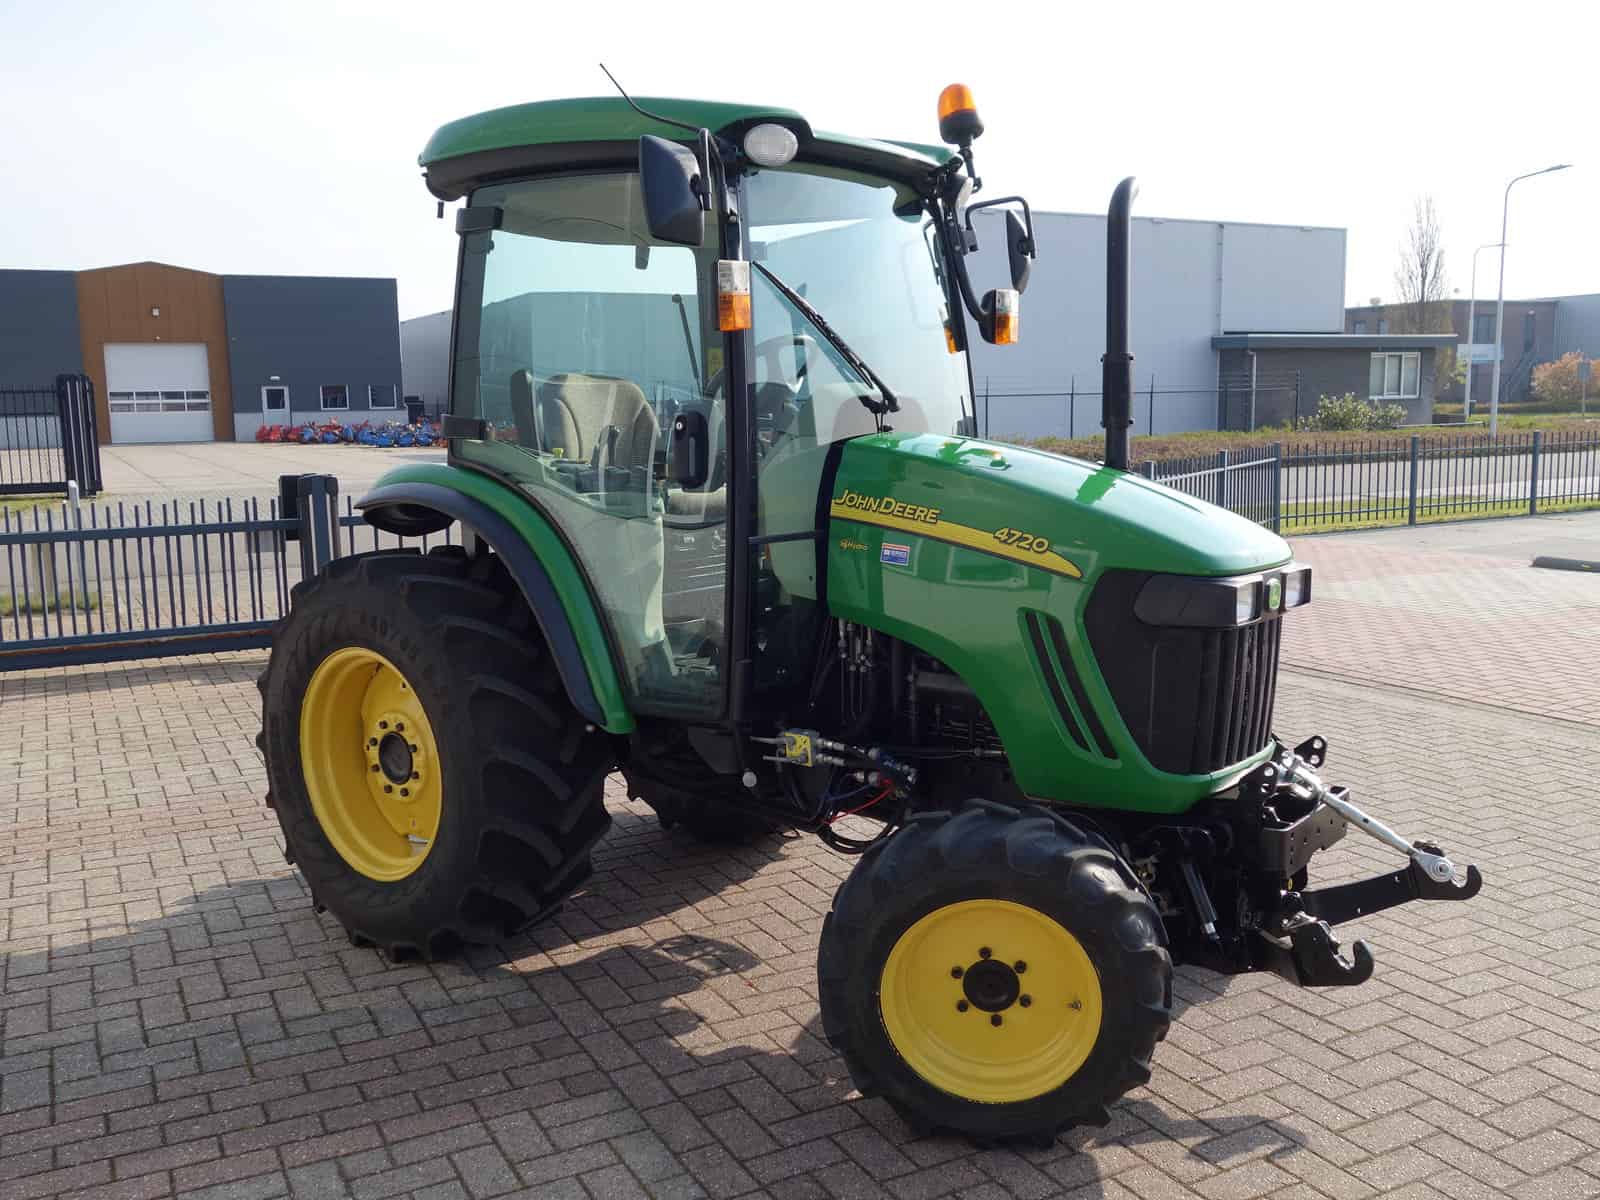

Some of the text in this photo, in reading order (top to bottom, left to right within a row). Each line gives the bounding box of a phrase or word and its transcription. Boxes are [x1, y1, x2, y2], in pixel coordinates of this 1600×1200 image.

[834, 489, 940, 523] JOHN DEERE
[994, 527, 1049, 553] 4720
